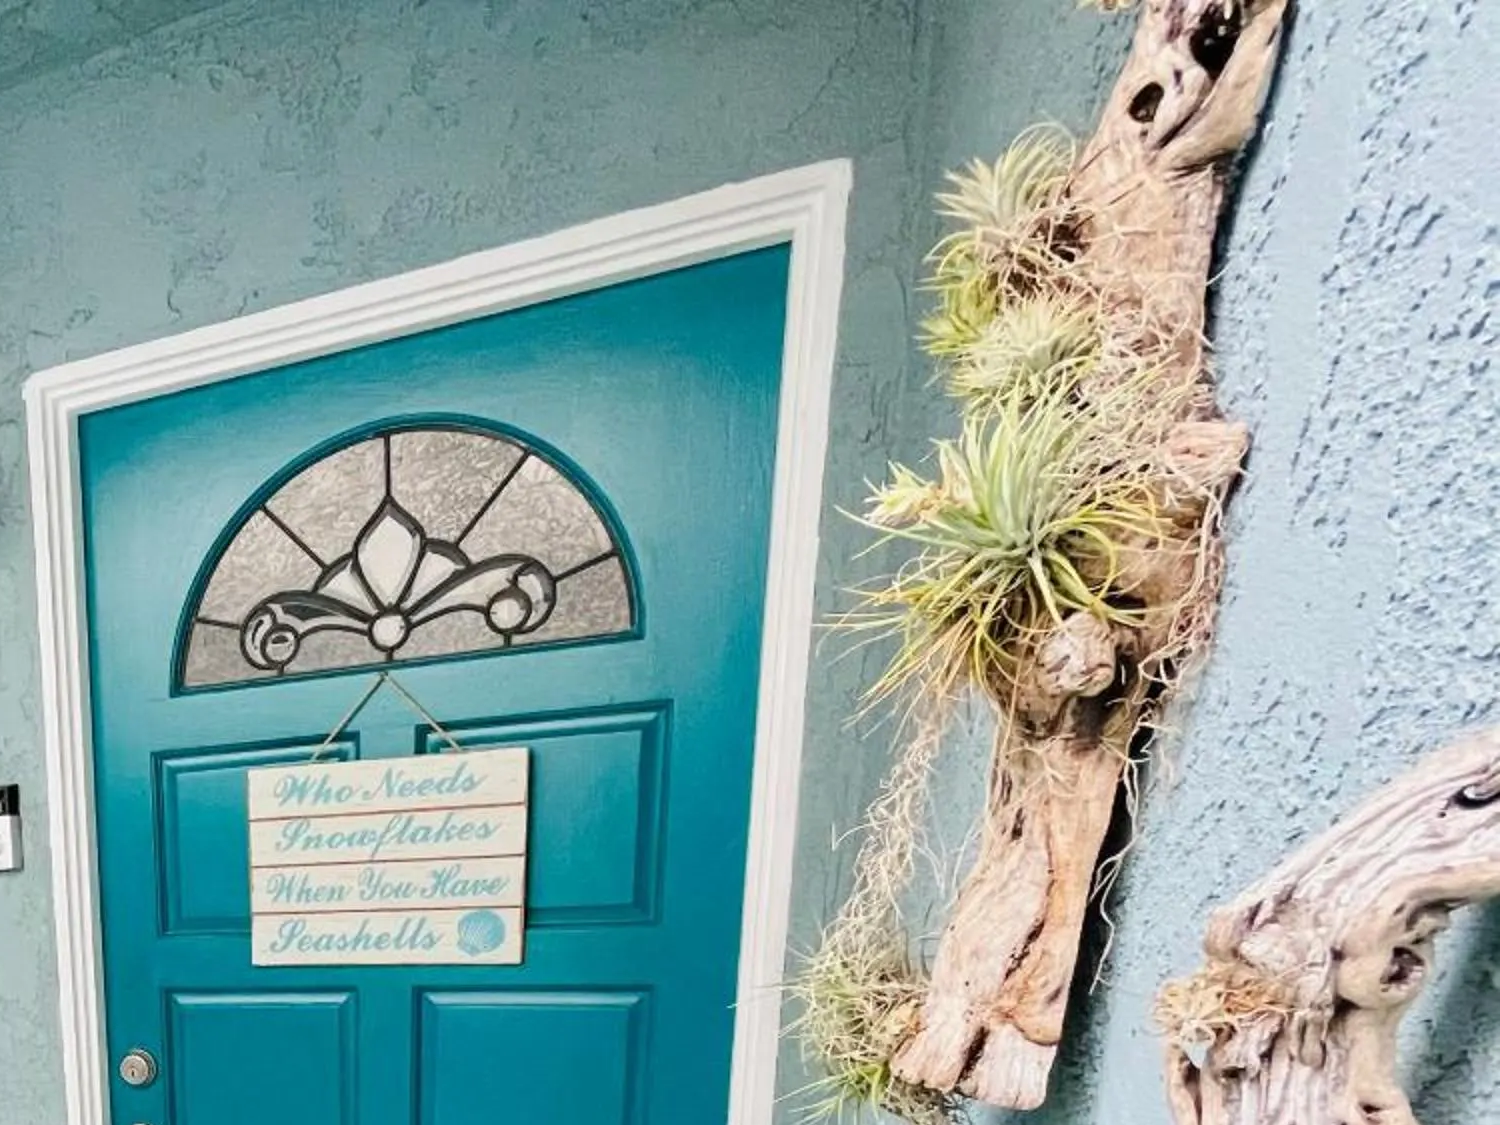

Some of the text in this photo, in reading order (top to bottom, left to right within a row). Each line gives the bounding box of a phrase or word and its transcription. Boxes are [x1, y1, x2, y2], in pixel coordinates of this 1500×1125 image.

[273, 762, 489, 806] Who Needs
[275, 811, 501, 859] Snowflakes
[267, 864, 510, 904] When You Have
[270, 917, 445, 954] Seashells
